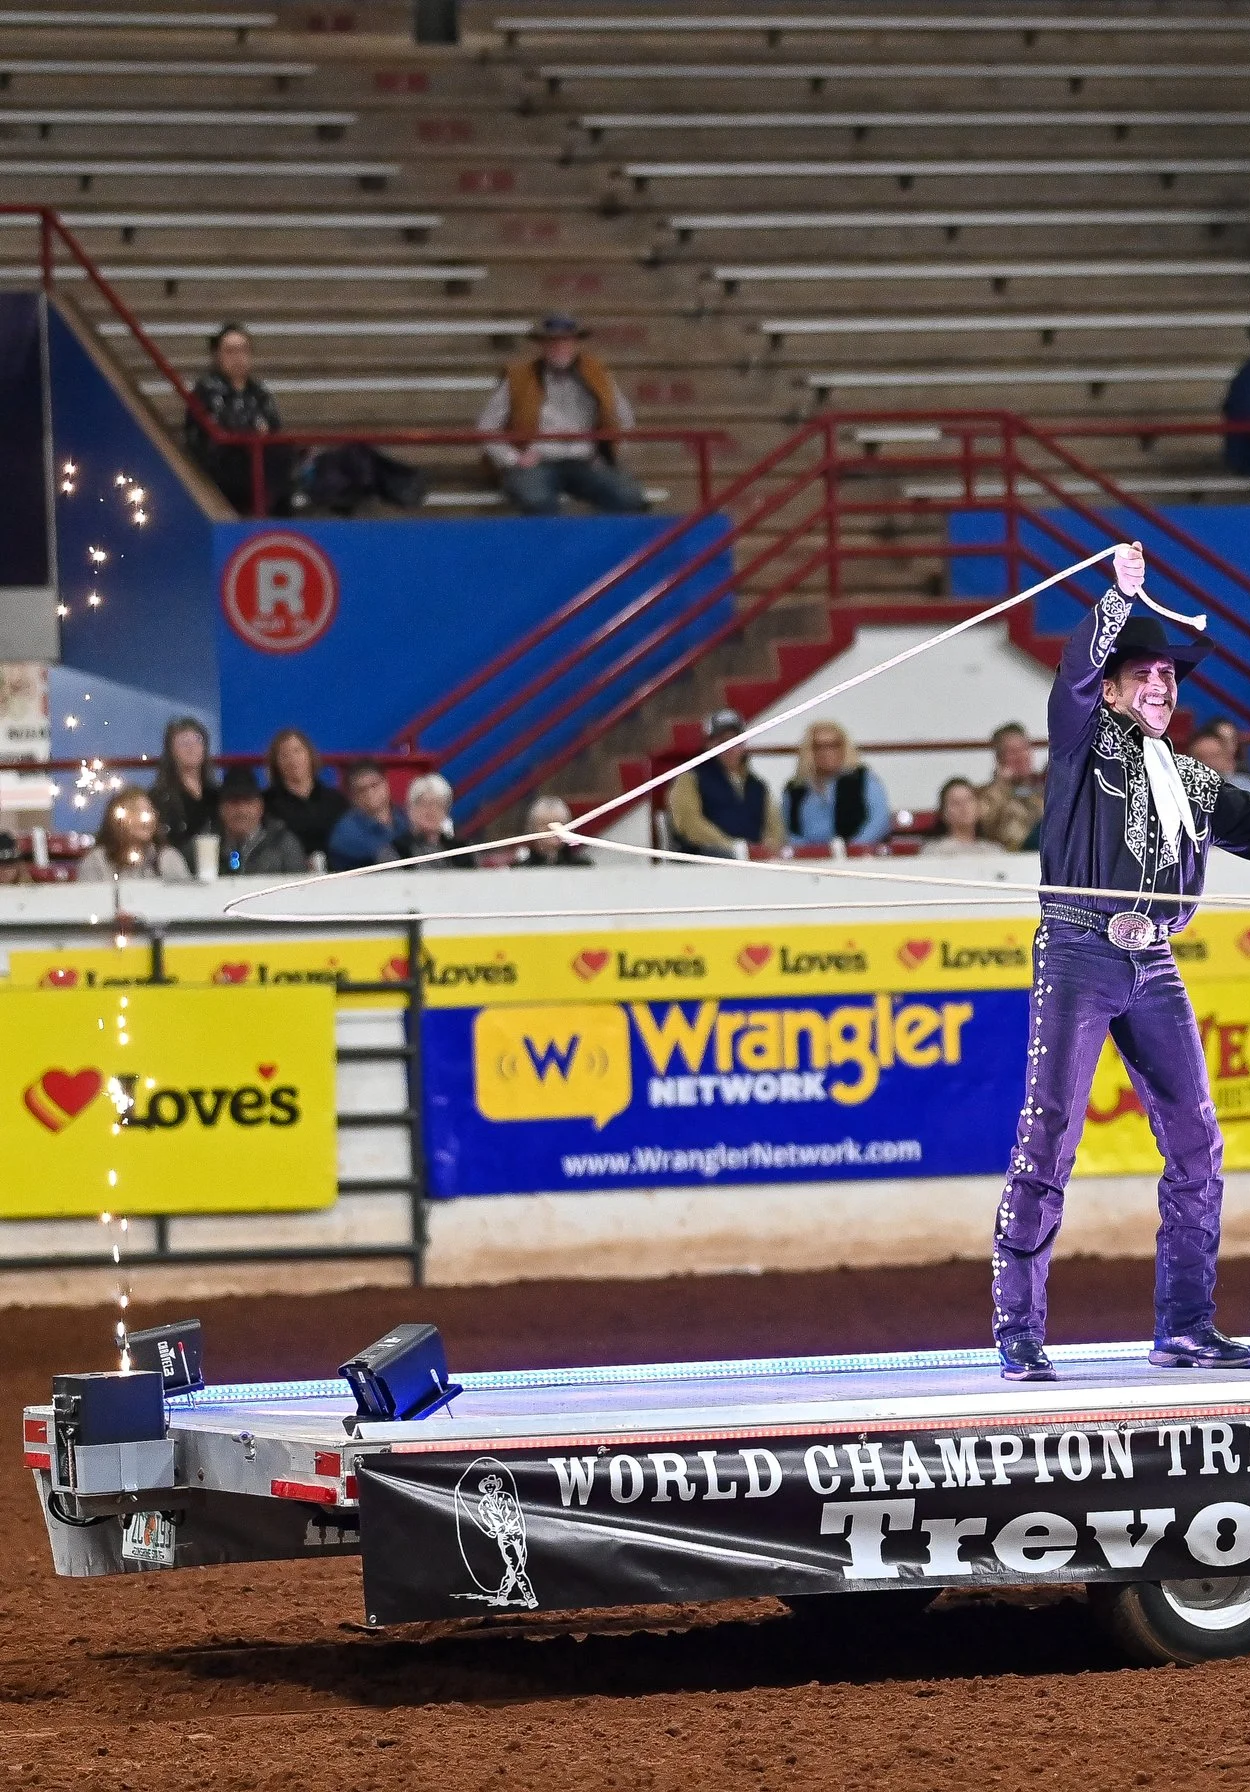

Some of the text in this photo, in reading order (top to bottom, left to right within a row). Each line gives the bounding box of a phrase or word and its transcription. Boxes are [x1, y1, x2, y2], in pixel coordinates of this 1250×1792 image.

[256, 558, 305, 614] R
[523, 1033, 581, 1083] W
[629, 992, 974, 1106] Wrangler
[649, 1072, 827, 1109] NETWORK
[562, 1138, 923, 1177] www.WranglerNetwork.com
[547, 1447, 783, 1506] WORLD
[803, 1428, 1136, 1495] CHAMPION
